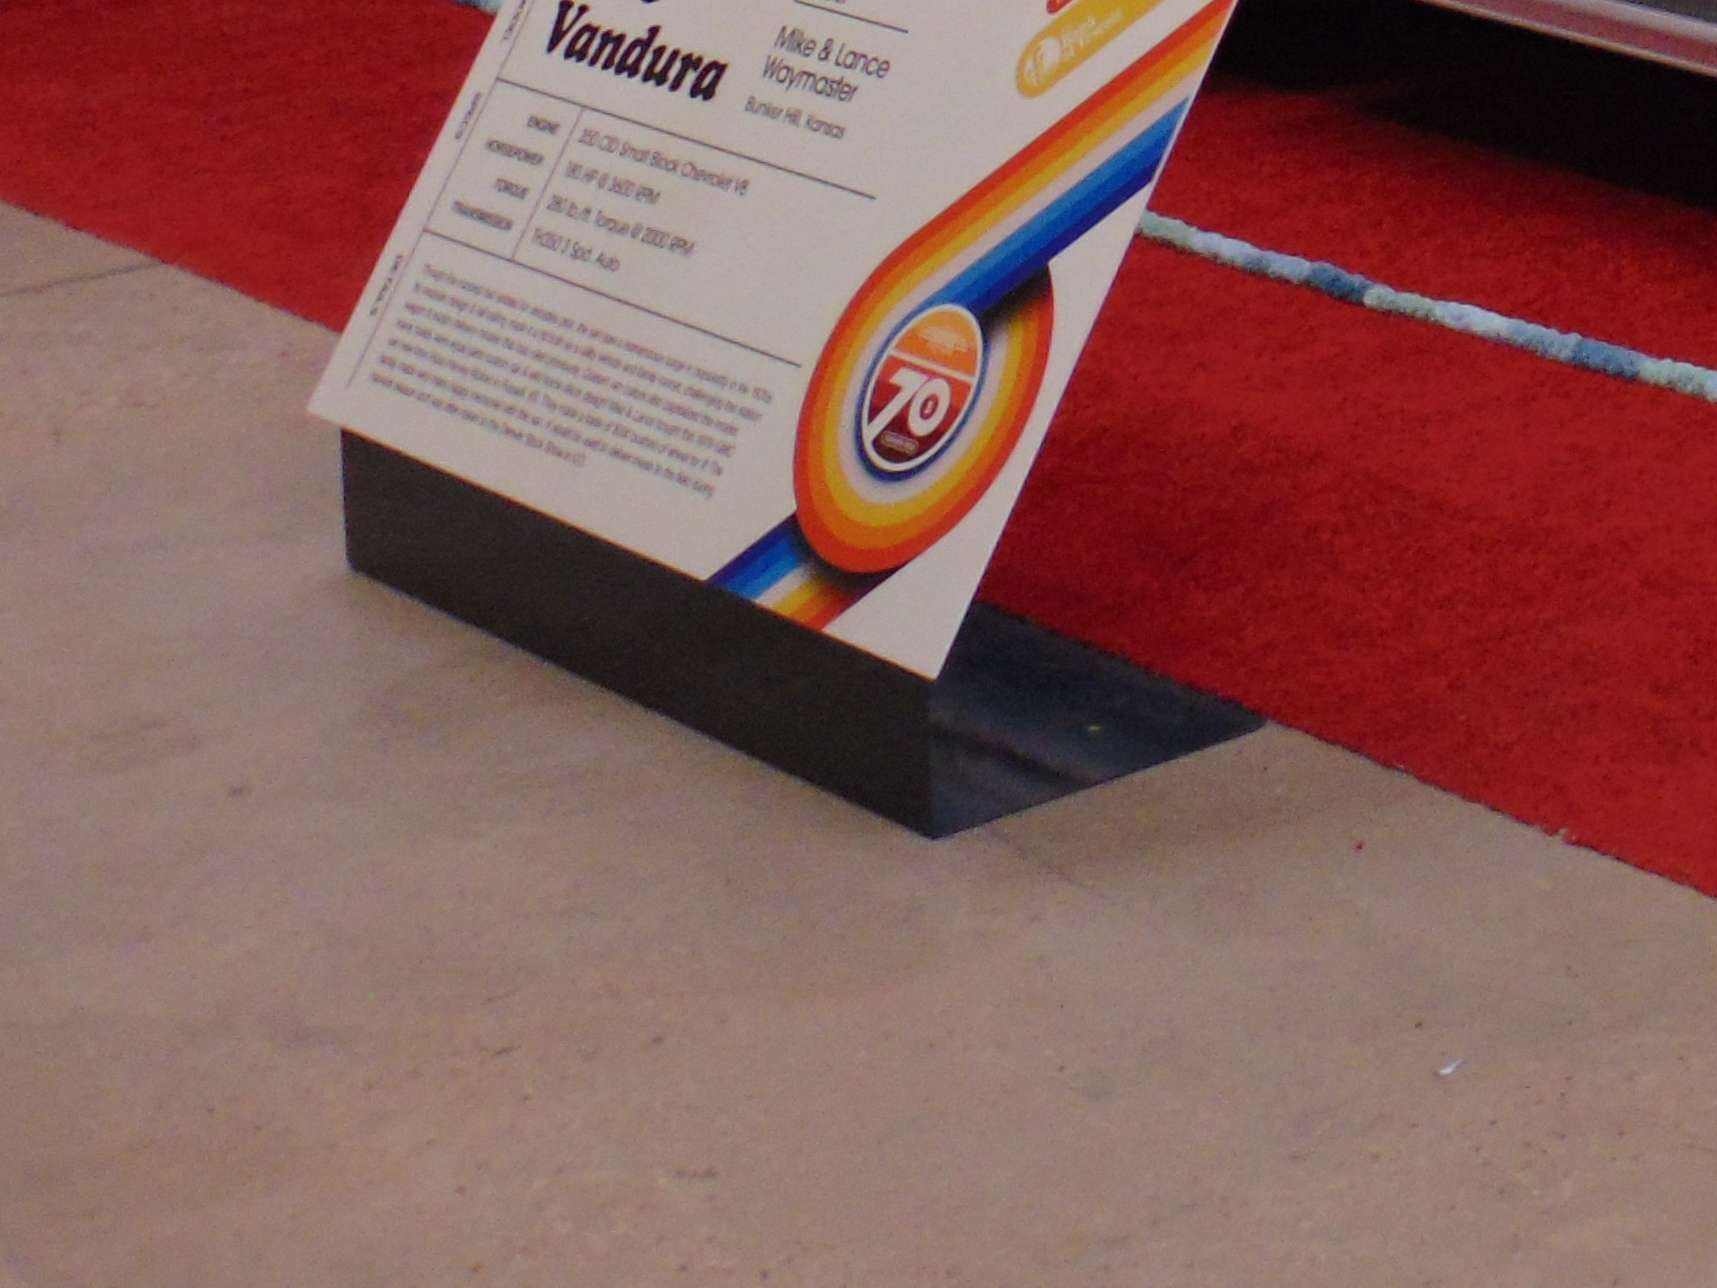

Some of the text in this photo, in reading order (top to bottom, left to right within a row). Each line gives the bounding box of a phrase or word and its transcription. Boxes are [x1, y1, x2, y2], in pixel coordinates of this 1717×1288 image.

[774, 26, 890, 79] Mike & Lance
[763, 55, 858, 101] Waymaster
[805, 115, 845, 139] Kansas
